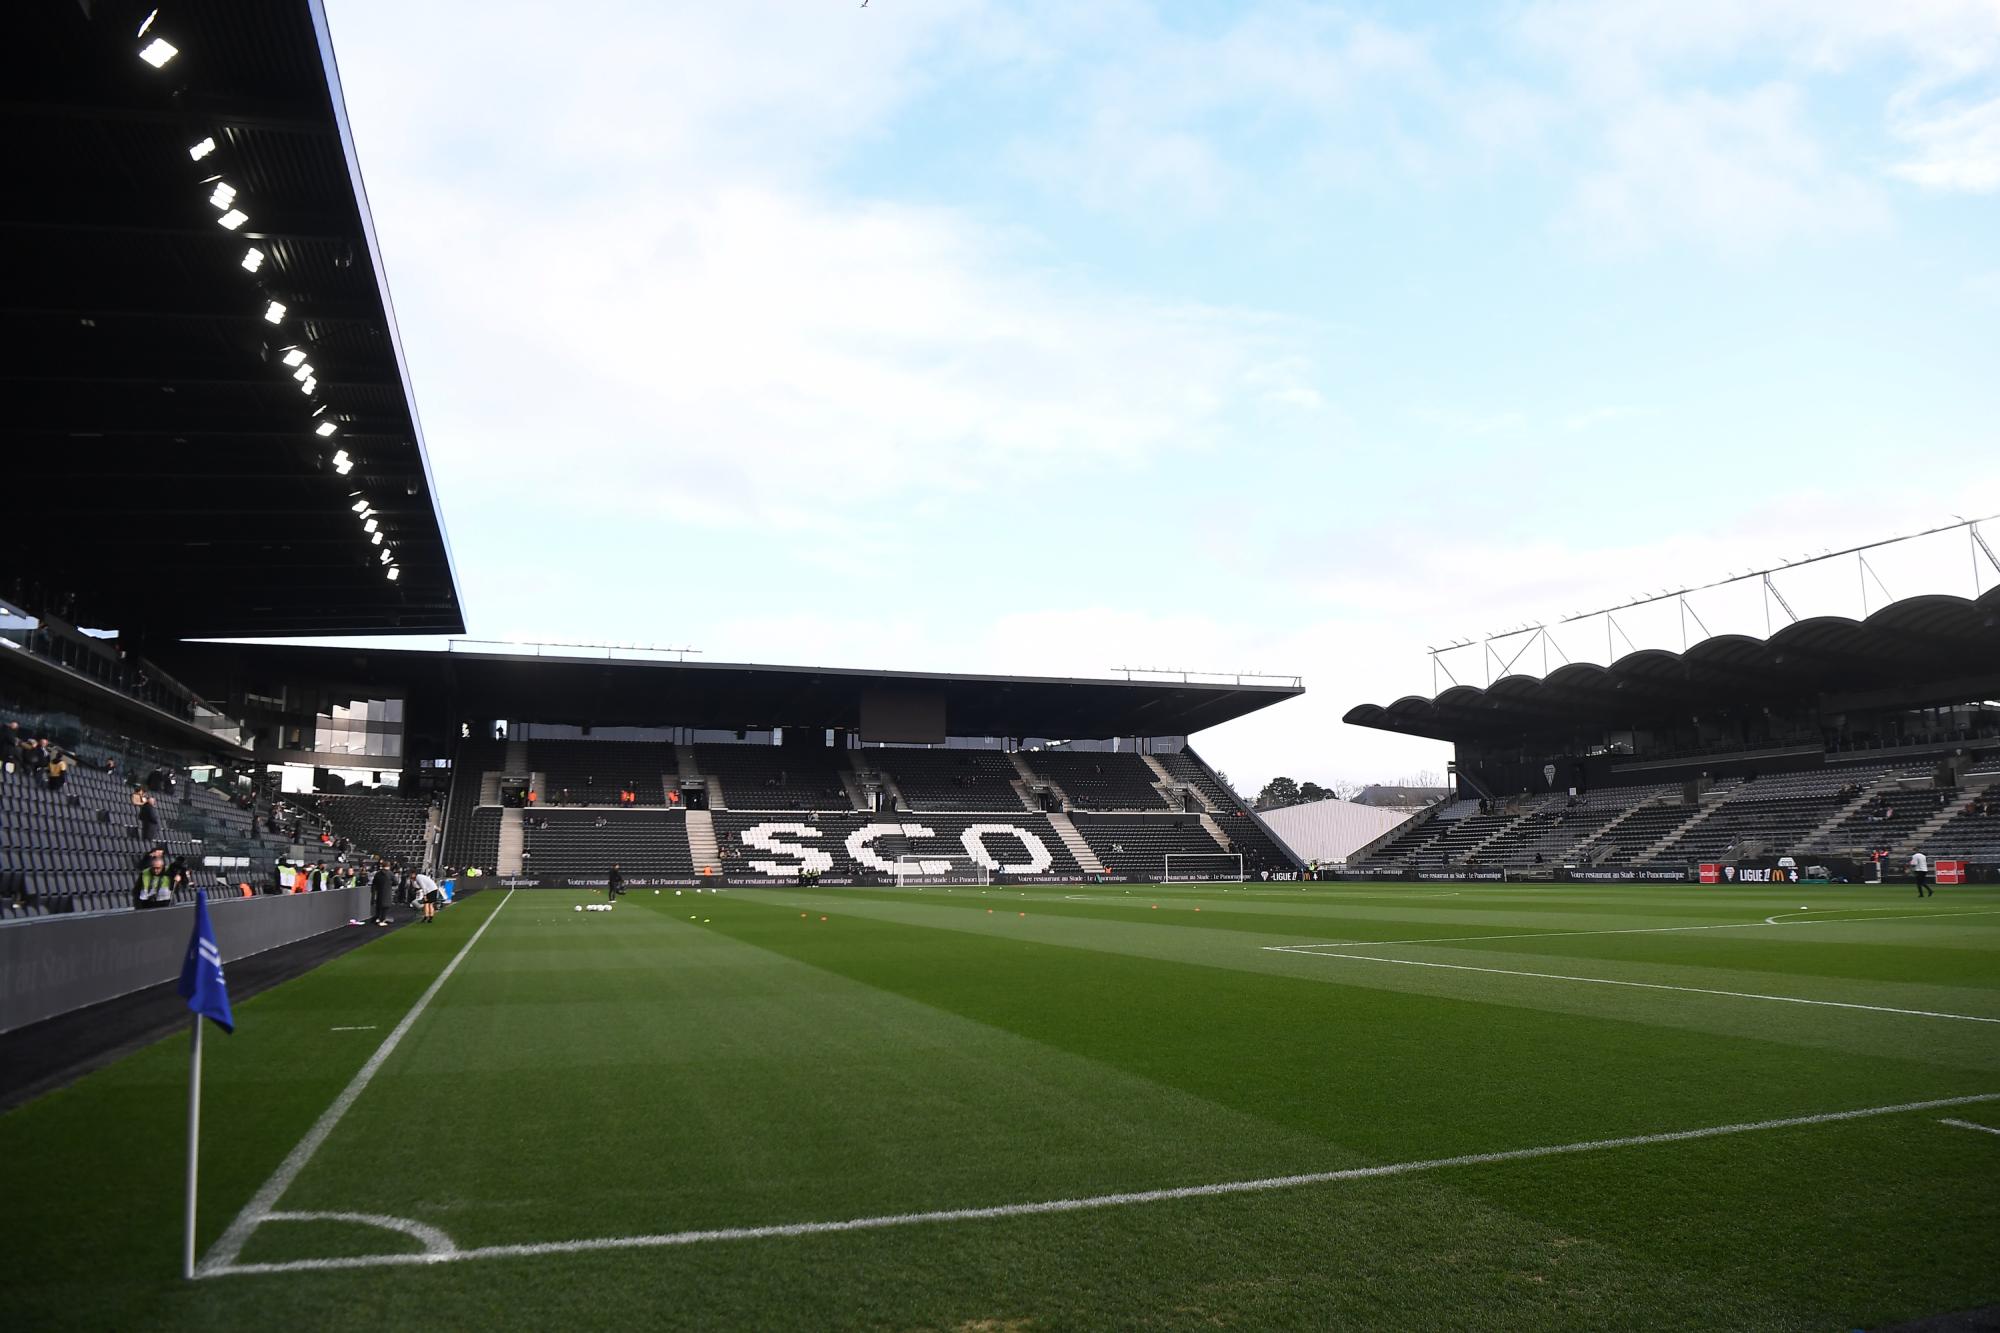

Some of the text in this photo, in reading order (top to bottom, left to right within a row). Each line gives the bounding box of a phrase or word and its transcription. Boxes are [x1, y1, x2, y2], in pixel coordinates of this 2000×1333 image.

[741, 823, 1053, 876] SCO
[1272, 872, 1291, 880] LIGUE
[1474, 872, 1501, 880] Panoramique
[1647, 871, 1685, 879] Panoramique
[1740, 869, 1763, 881] LIGUE
[660, 878, 701, 886] Panoramique
